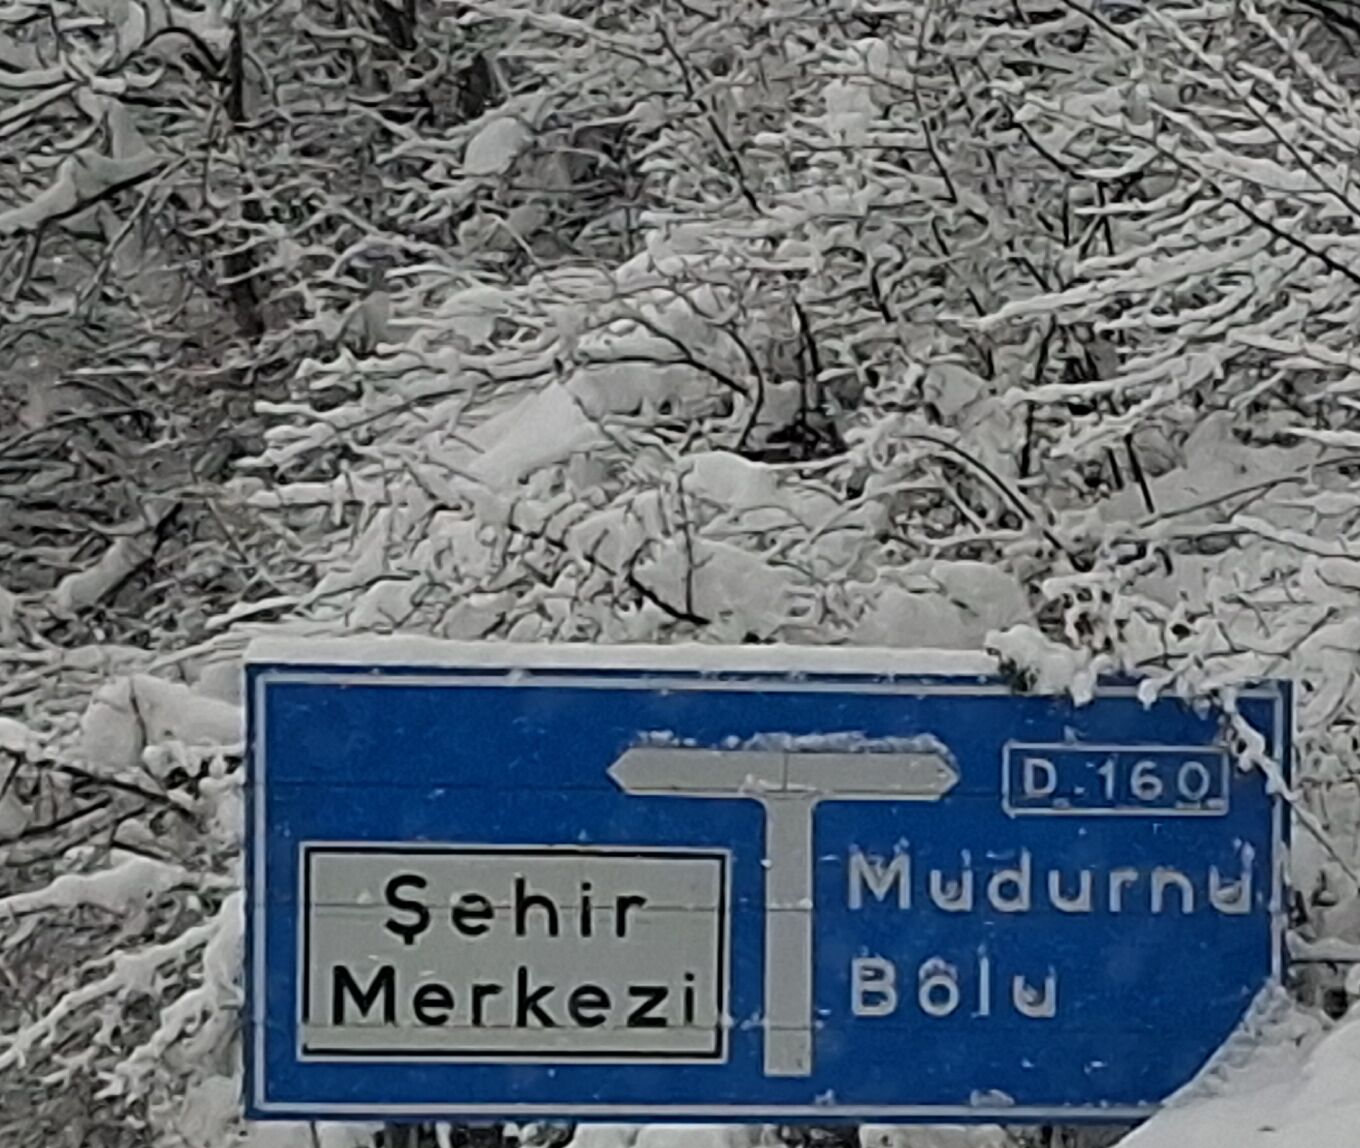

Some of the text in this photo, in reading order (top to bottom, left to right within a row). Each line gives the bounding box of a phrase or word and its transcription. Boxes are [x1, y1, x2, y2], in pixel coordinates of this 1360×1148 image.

[383, 873, 648, 945] Şehir
[848, 848, 1252, 914] Mudurnu
[331, 964, 696, 1028] Merkezi
[850, 954, 1056, 1018] Bolu
